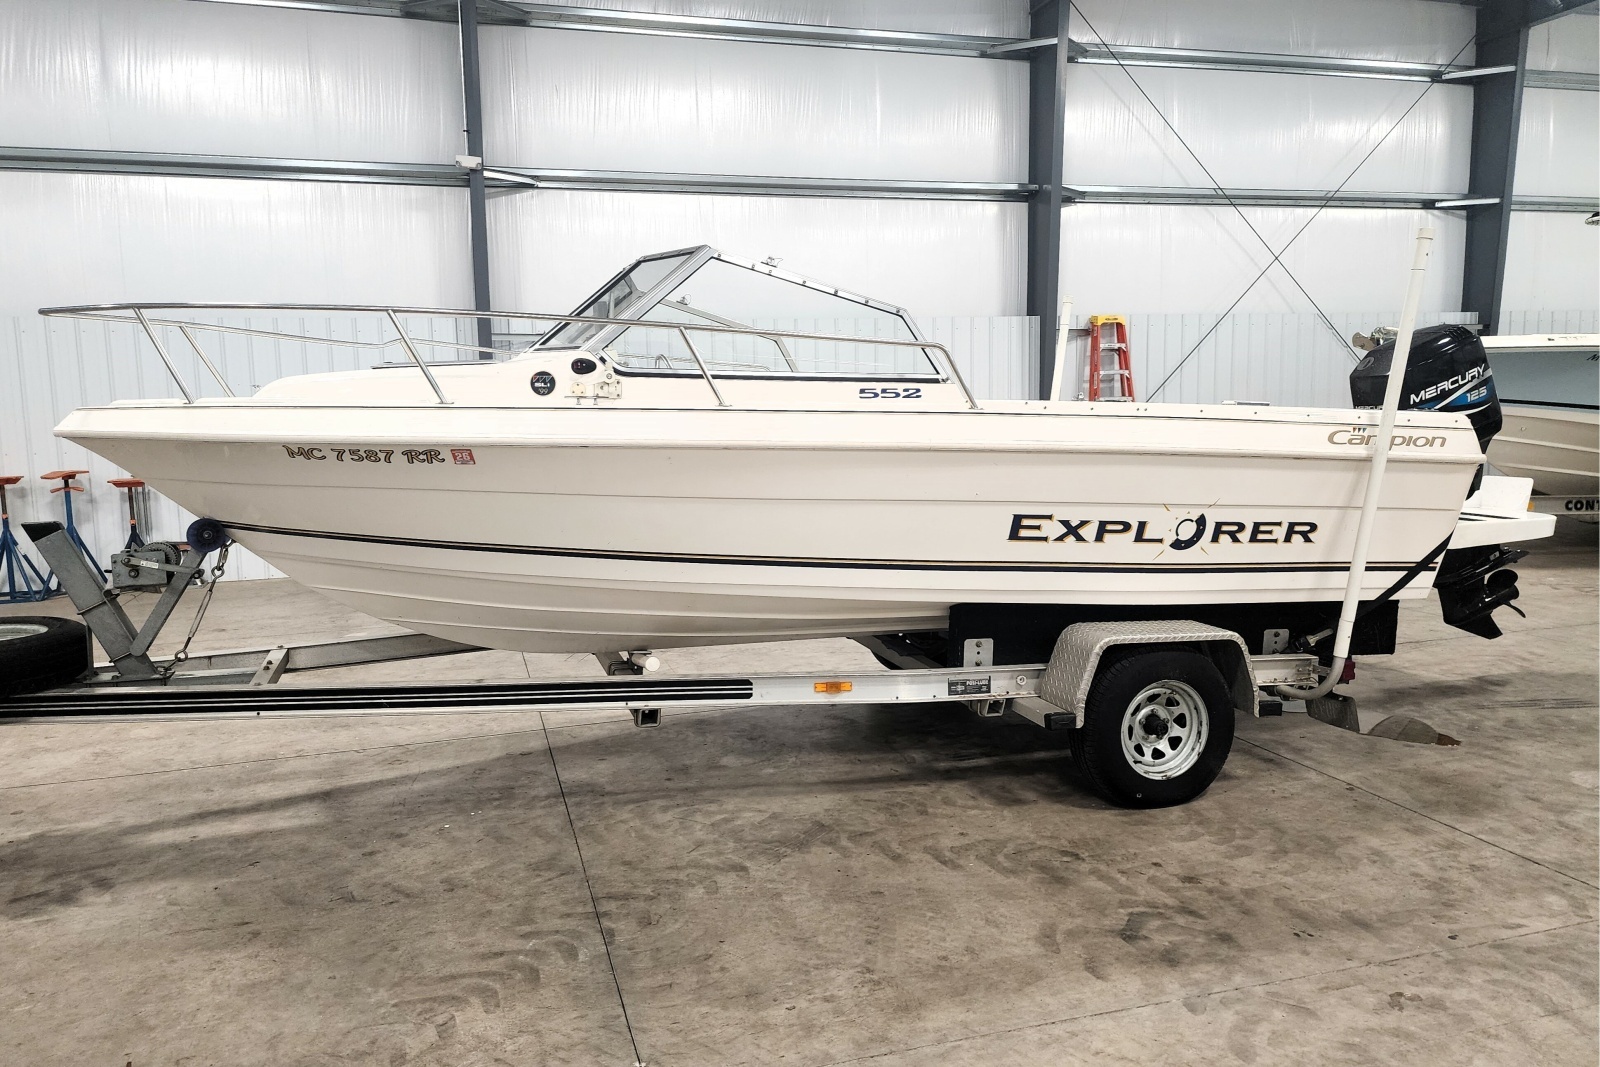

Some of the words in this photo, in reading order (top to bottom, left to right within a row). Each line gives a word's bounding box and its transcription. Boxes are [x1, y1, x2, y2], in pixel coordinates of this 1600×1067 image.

[859, 388, 922, 399] 552
[1410, 364, 1486, 405] MERCURY
[1466, 386, 1487, 402] 125
[282, 444, 327, 460] MC
[331, 448, 395, 463] 7587
[401, 449, 446, 464] RR
[455, 453, 470, 461] 26
[1006, 512, 1319, 551] EXPLORER
